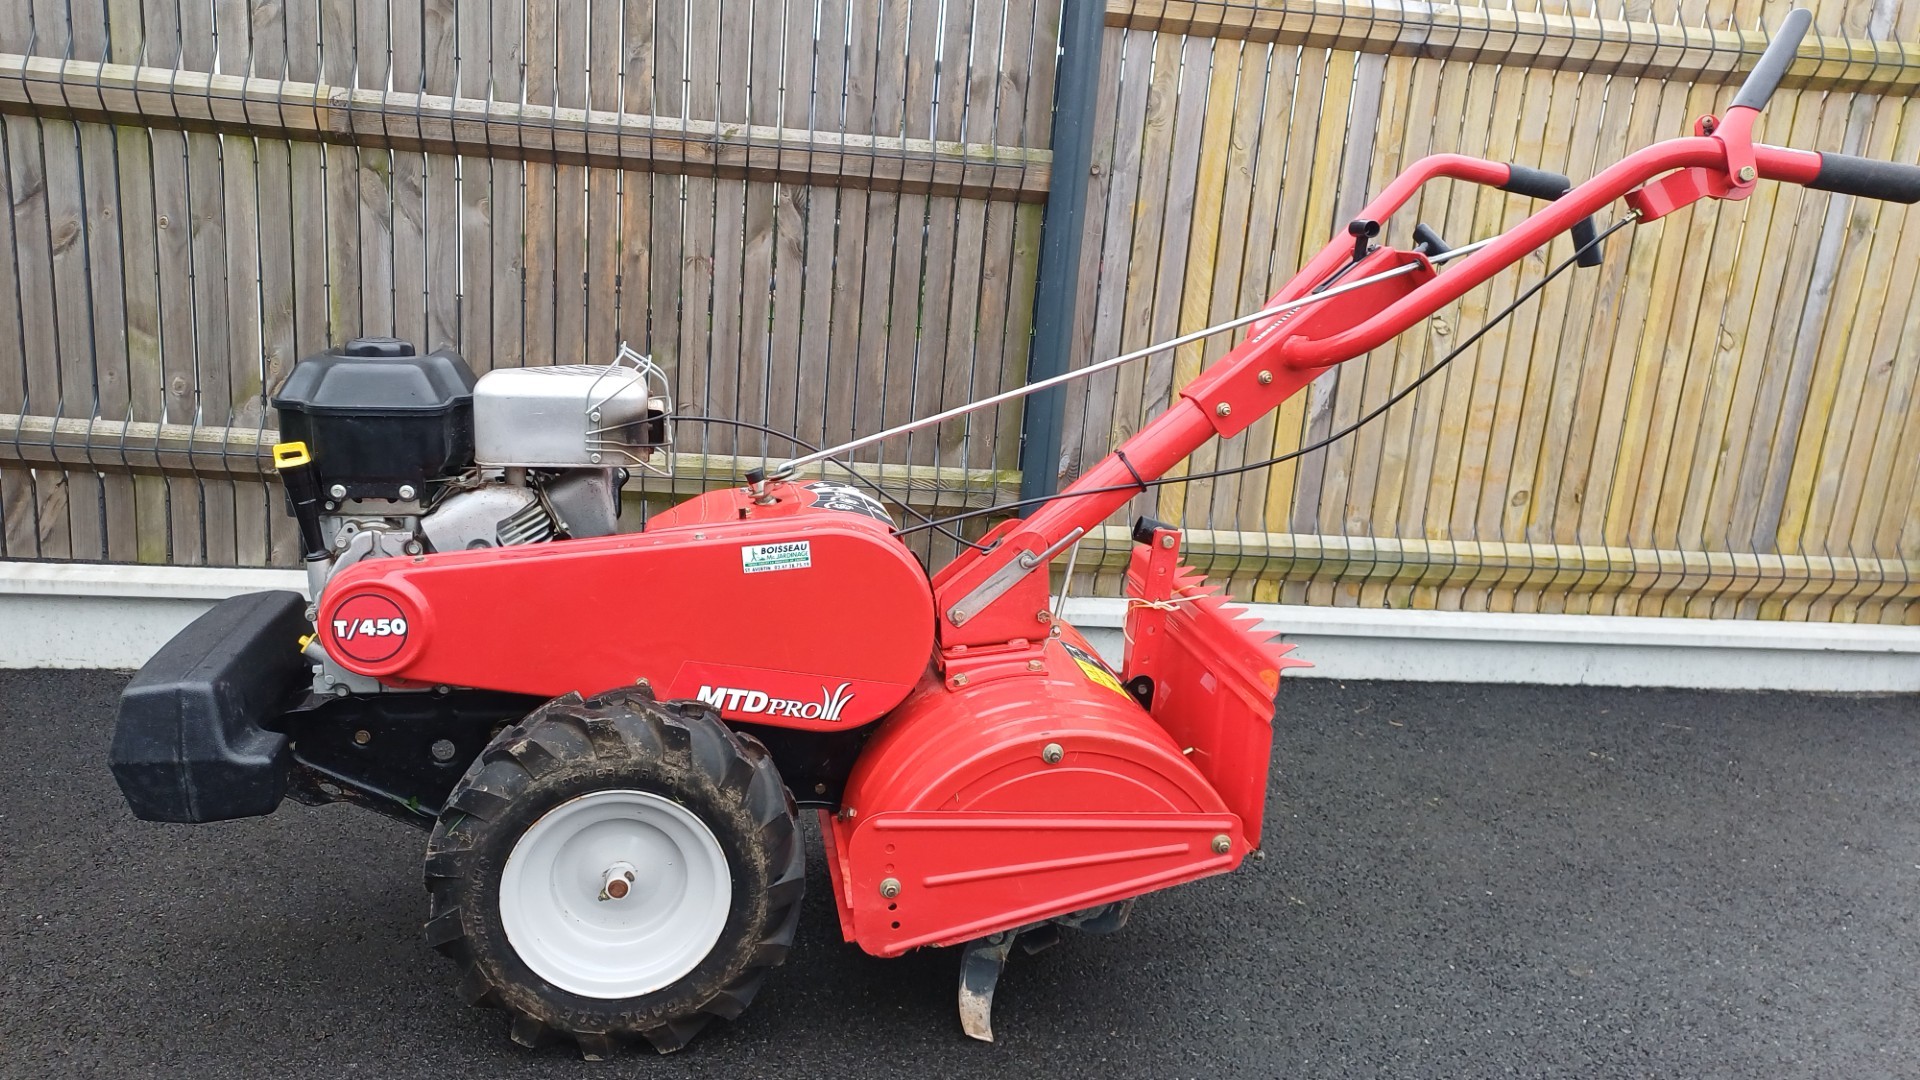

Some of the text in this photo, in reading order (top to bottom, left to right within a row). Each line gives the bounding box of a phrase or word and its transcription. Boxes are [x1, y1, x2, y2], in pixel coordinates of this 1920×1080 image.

[761, 544, 808, 555] BOISSEAU
[777, 551, 809, 559] JARDINAGE
[333, 617, 407, 641] T/450
